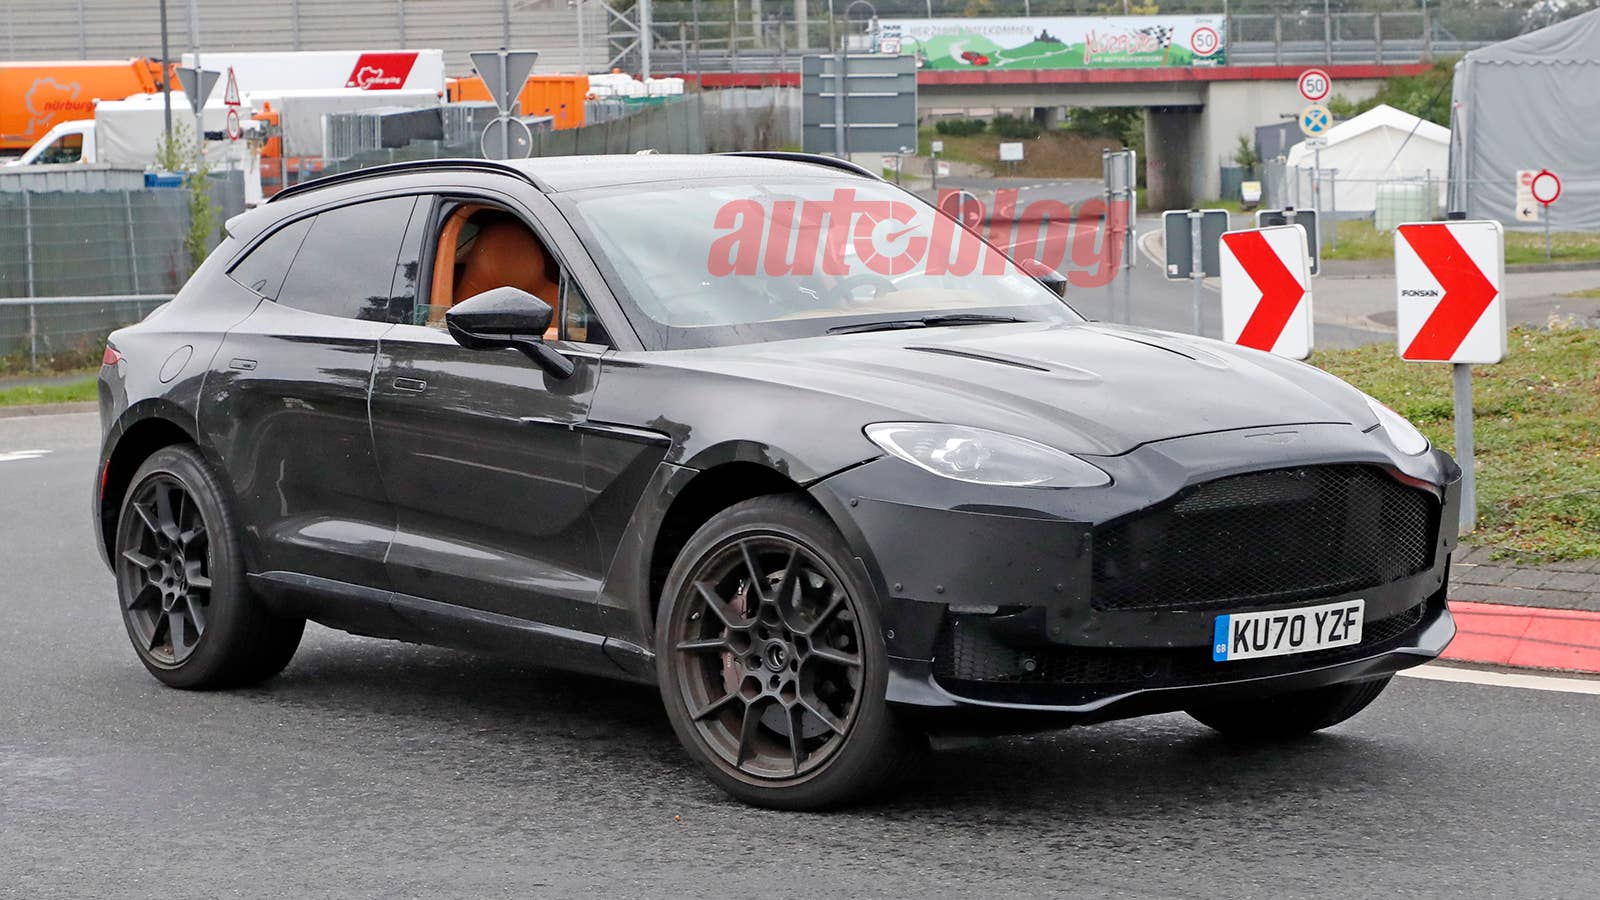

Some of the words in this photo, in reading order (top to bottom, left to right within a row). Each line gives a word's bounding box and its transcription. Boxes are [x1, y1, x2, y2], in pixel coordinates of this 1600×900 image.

[1197, 34, 1213, 47] 50
[1306, 79, 1324, 93] 50
[44, 100, 95, 112] nürburg
[1233, 614, 1305, 653] KU70
[1314, 606, 1360, 645] YZF
[1215, 643, 1226, 653] GB
